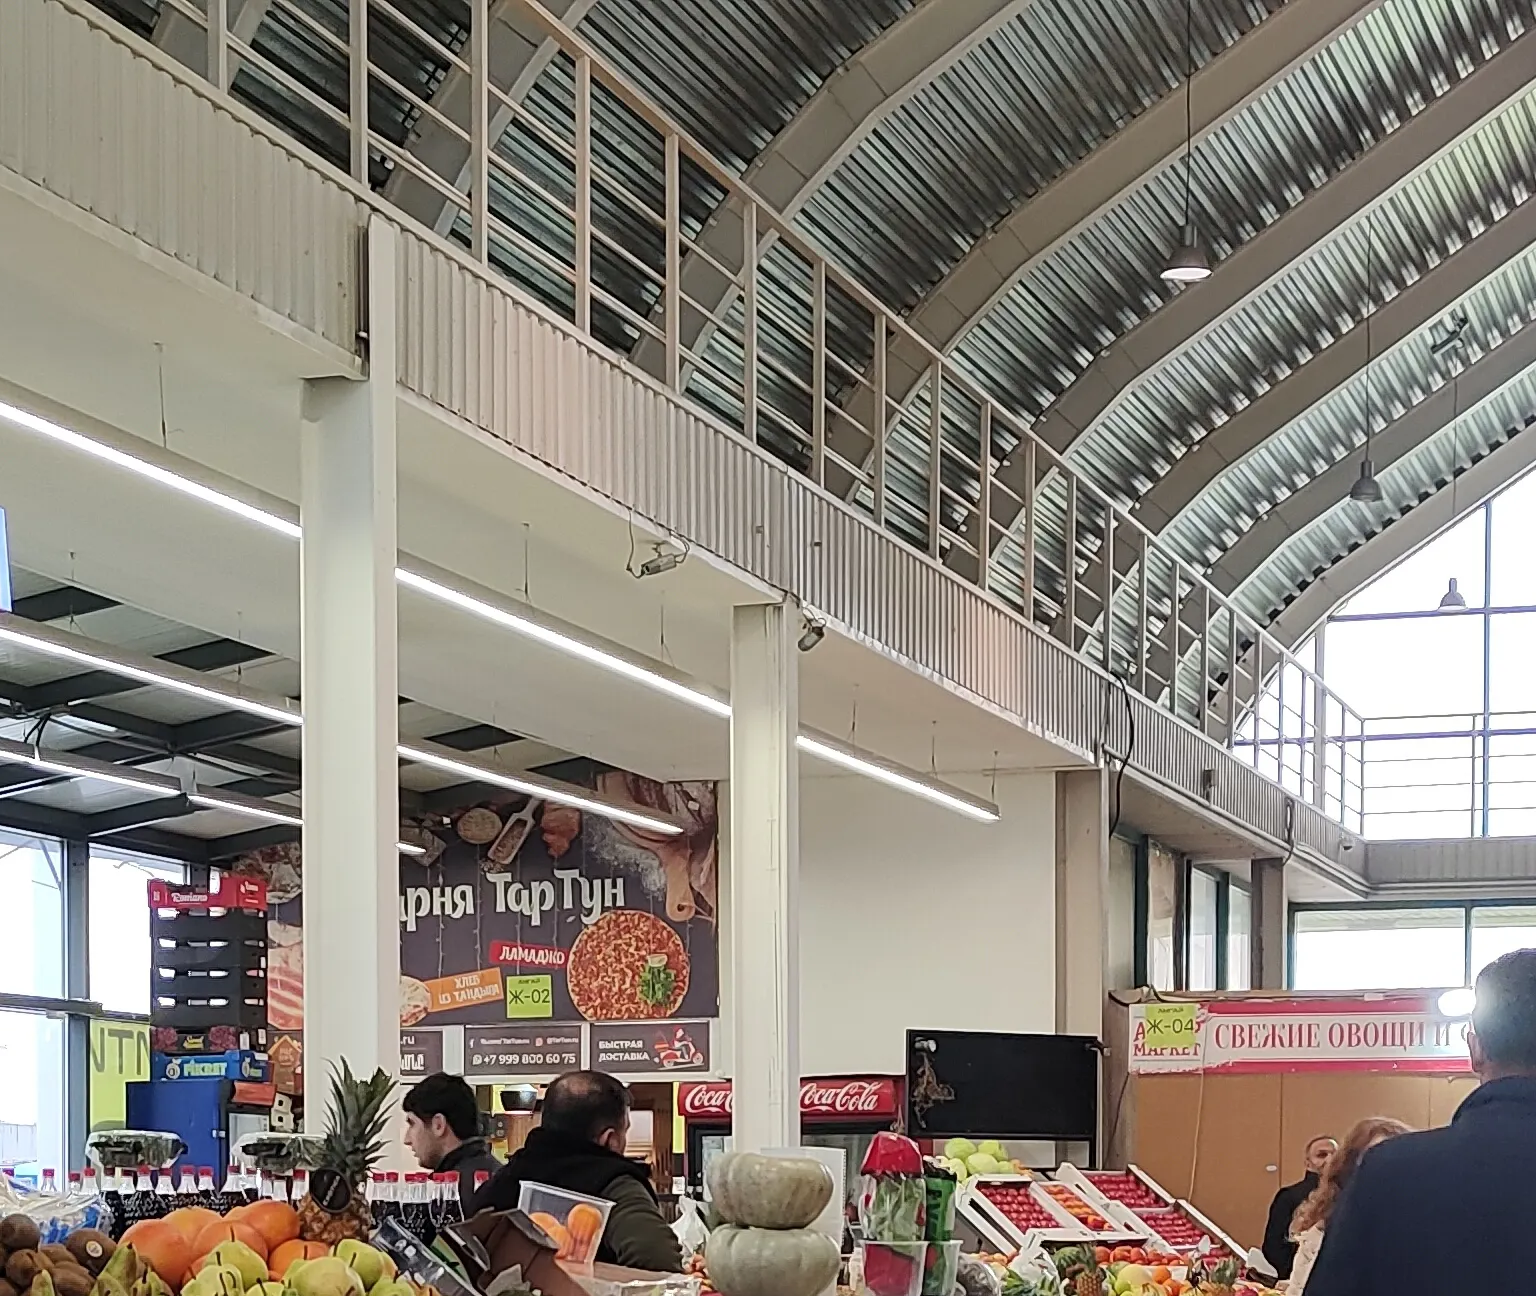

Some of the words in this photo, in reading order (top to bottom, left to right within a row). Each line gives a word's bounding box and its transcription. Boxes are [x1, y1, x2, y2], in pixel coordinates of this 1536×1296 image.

[454, 974, 480, 989] ХЛЕБ
[509, 988, 550, 1005] Ж-02
[1147, 1018, 1195, 1035] Ж-04
[1215, 1022, 1321, 1049] СВЕЖИЕ
[1328, 1020, 1425, 1051] ОВОЩИ
[599, 1039, 643, 1050] БЫСТРАЯ
[562, 1053, 576, 1064] 75
[599, 1051, 650, 1063] ДОСТАВКА
